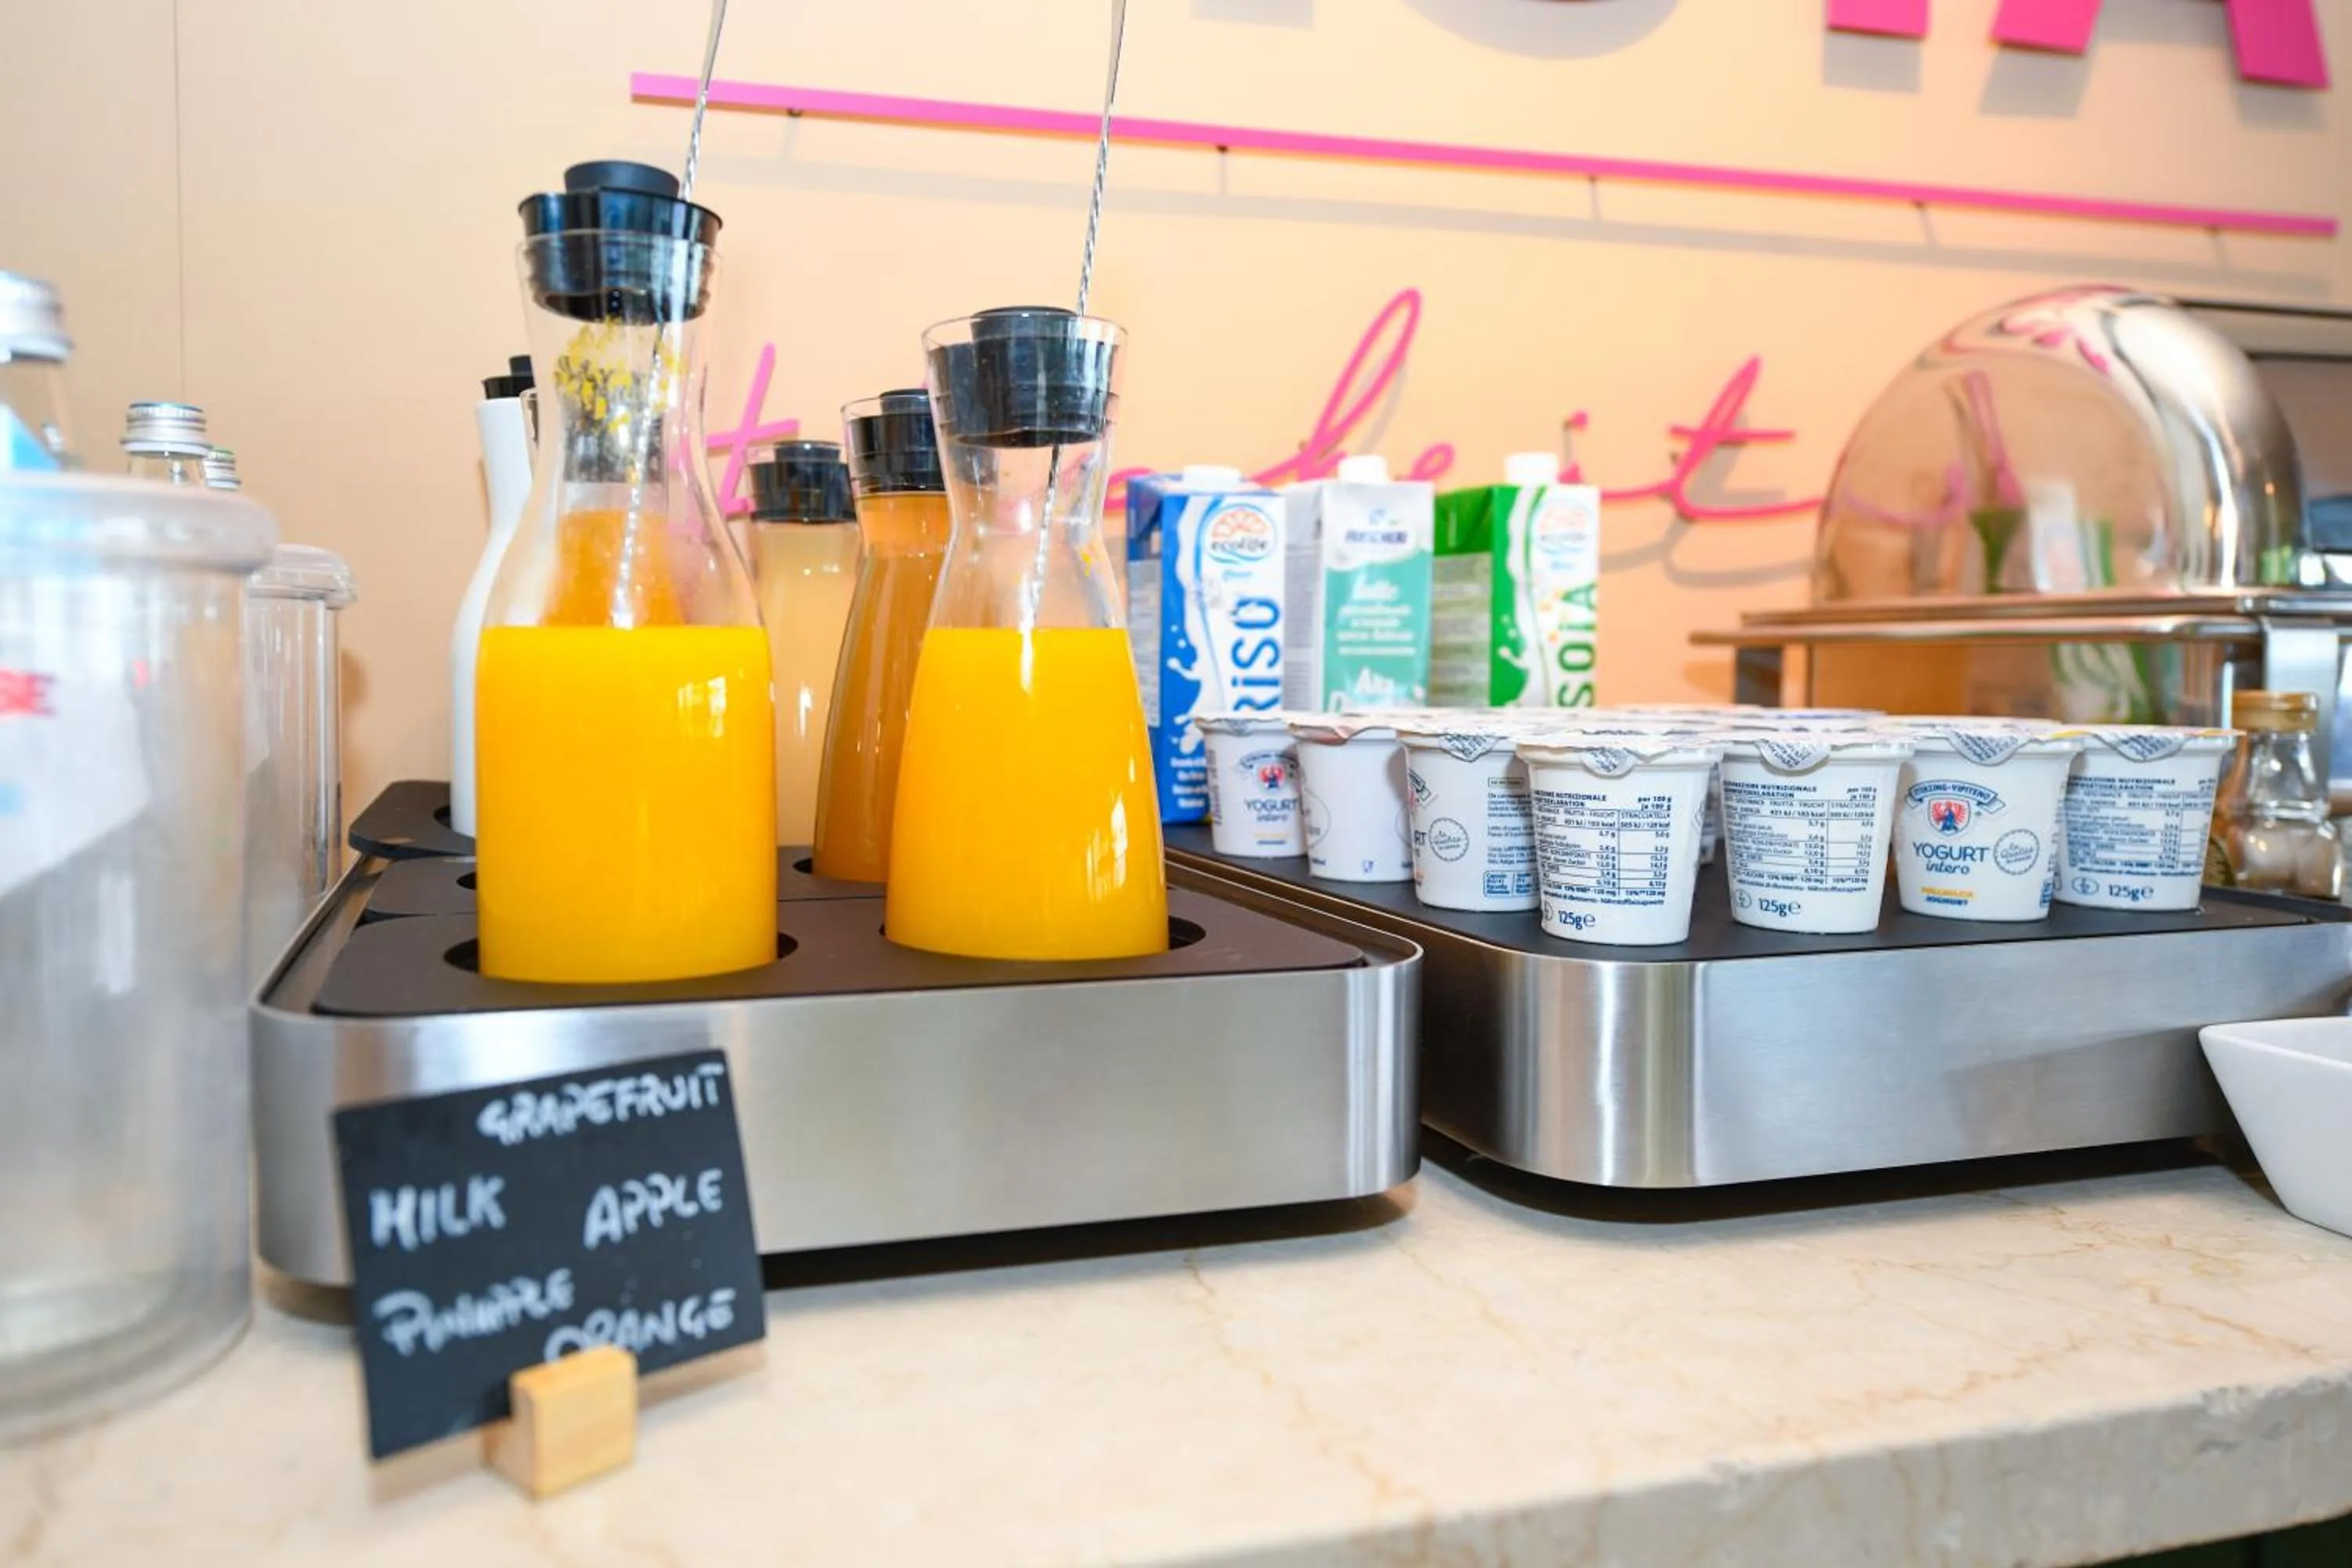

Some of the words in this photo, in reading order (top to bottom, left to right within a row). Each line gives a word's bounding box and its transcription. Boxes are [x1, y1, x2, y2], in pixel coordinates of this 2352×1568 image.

[1913, 841, 1990, 862] YOGURT
[1926, 860, 1970, 875] intero
[2108, 884, 2140, 902] 125g
[1759, 897, 1787, 917] 125g
[1558, 910, 1583, 930] 125g
[477, 1062, 724, 1146] GRAPEFRUIT
[583, 1167, 723, 1249] APPLE
